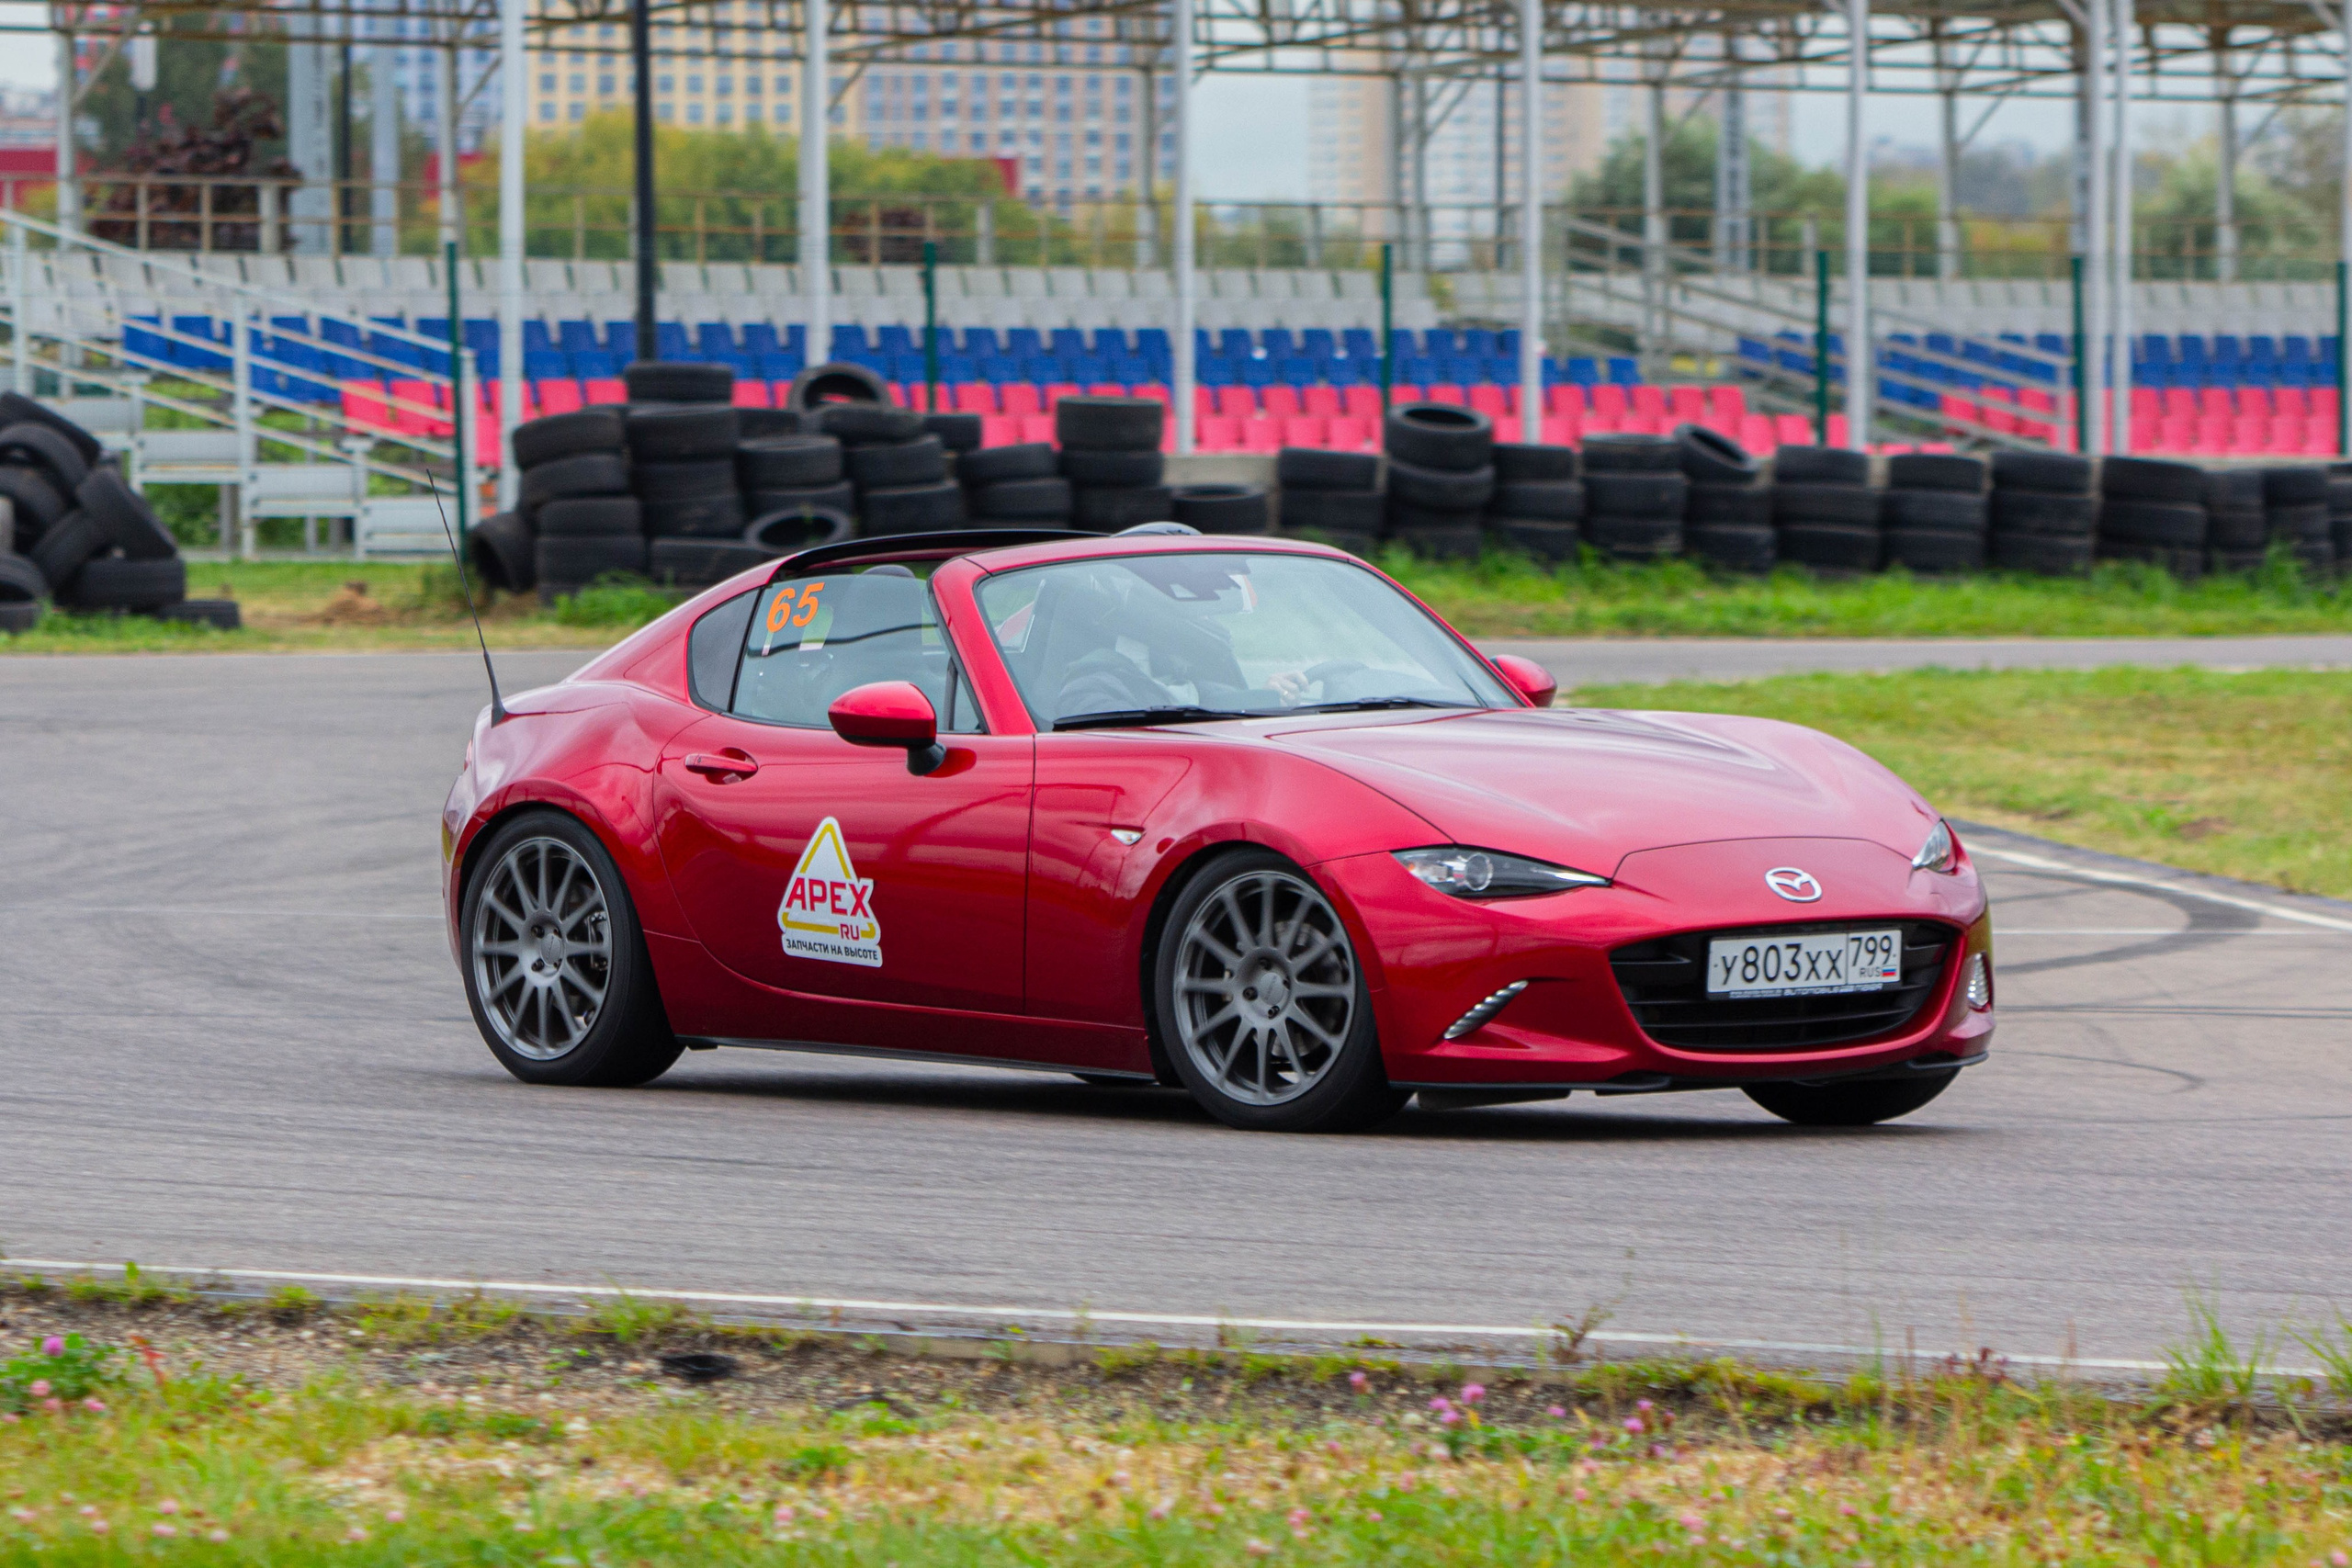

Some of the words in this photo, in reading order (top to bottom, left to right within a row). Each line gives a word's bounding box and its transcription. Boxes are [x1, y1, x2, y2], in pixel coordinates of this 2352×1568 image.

[766, 581, 825, 633] 65
[786, 877, 869, 919] APEX
[840, 923, 860, 942] RU
[786, 939, 829, 953] ЗАПЧАСТИ
[831, 944, 843, 955] НА
[845, 947, 877, 960] ВЫСОТЕ
[1850, 935, 1893, 966] 799
[1860, 967, 1882, 978] RUS
